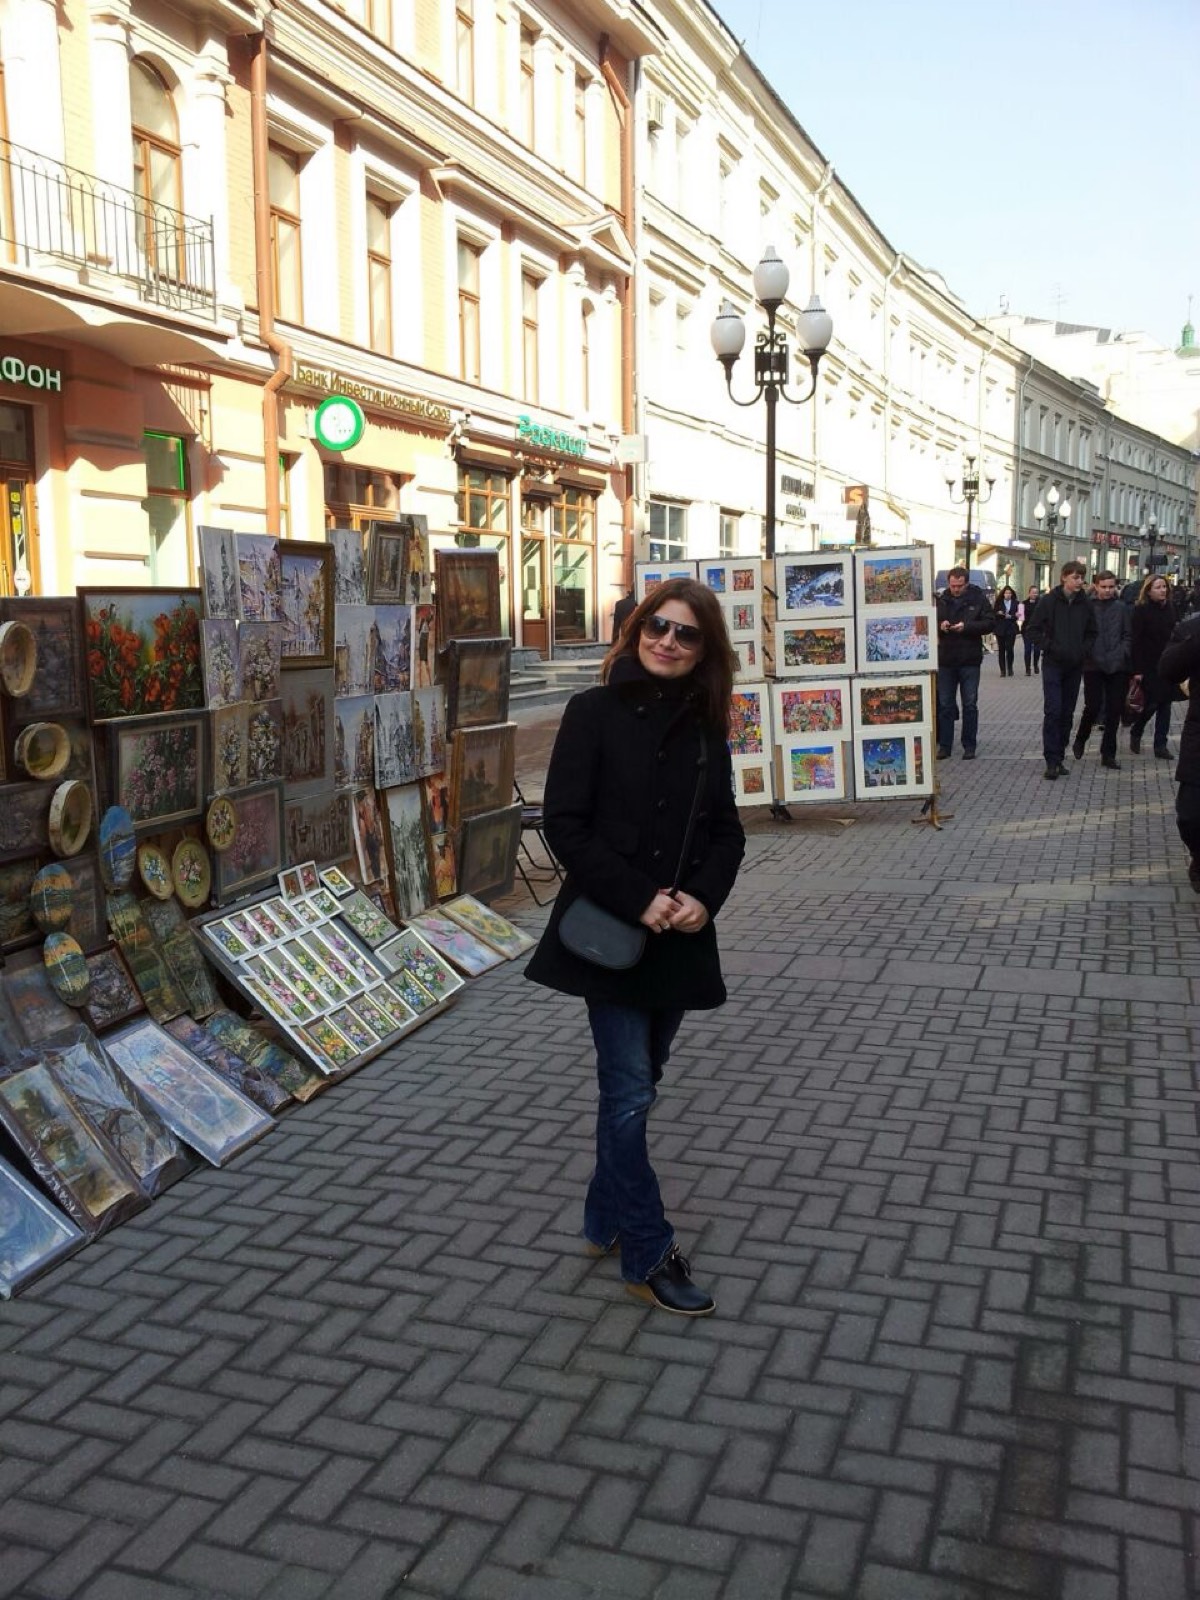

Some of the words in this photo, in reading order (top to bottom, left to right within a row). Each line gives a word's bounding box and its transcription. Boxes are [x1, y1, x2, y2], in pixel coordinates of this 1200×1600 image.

[0, 356, 61, 391] ФОН
[297, 362, 330, 389] Банк
[331, 371, 425, 416] Инвестиционный
[425, 400, 451, 423] Союз
